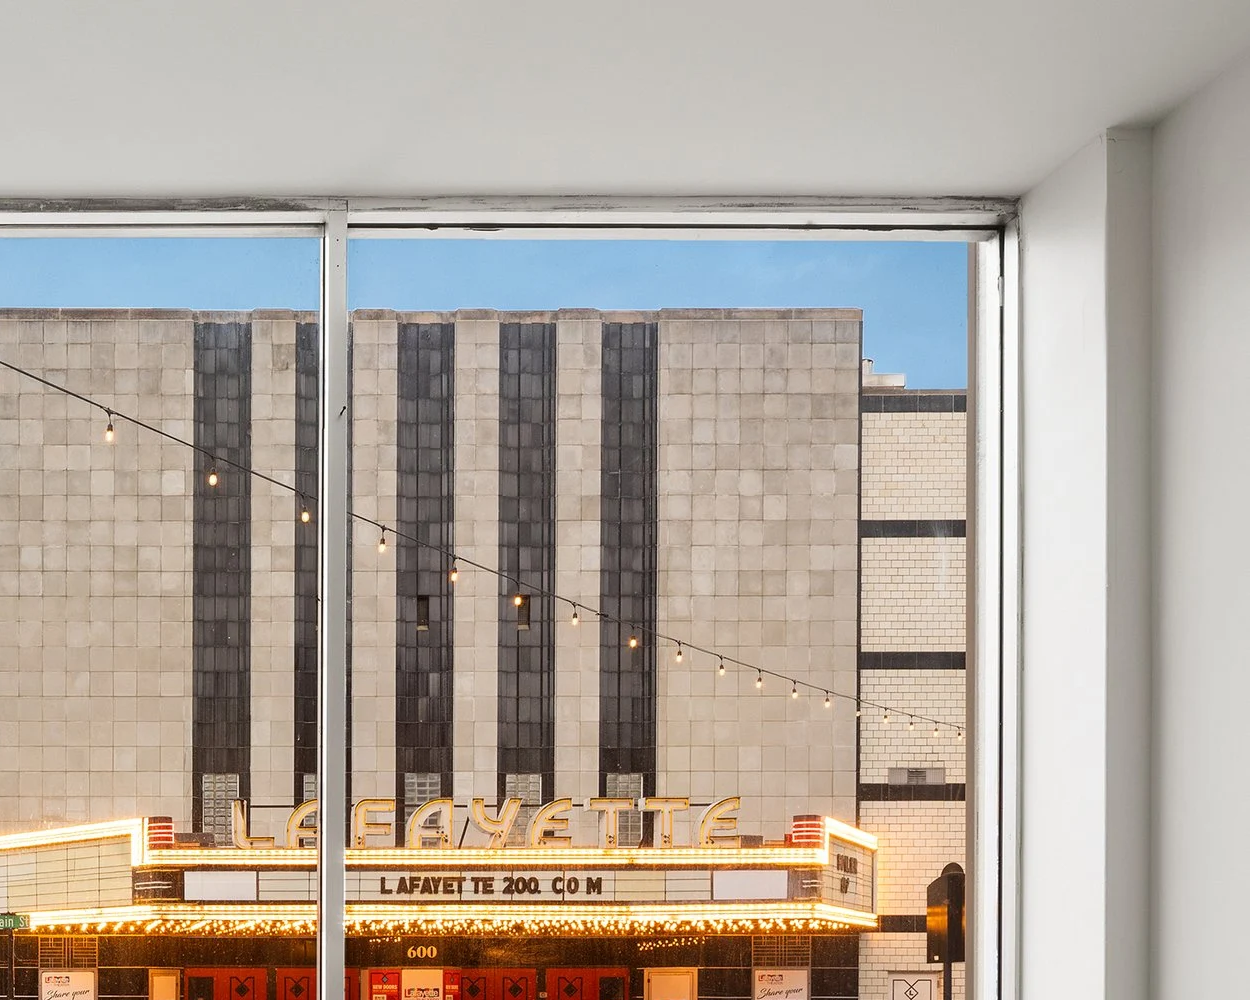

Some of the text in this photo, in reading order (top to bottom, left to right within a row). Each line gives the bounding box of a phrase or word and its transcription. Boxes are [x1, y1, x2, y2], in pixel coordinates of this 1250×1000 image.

[231, 797, 742, 850] LAFAYETTE
[19, 916, 29, 928] St
[407, 945, 438, 959] 600
[71, 989, 90, 1000] your
[757, 987, 804, 1000] Share your
